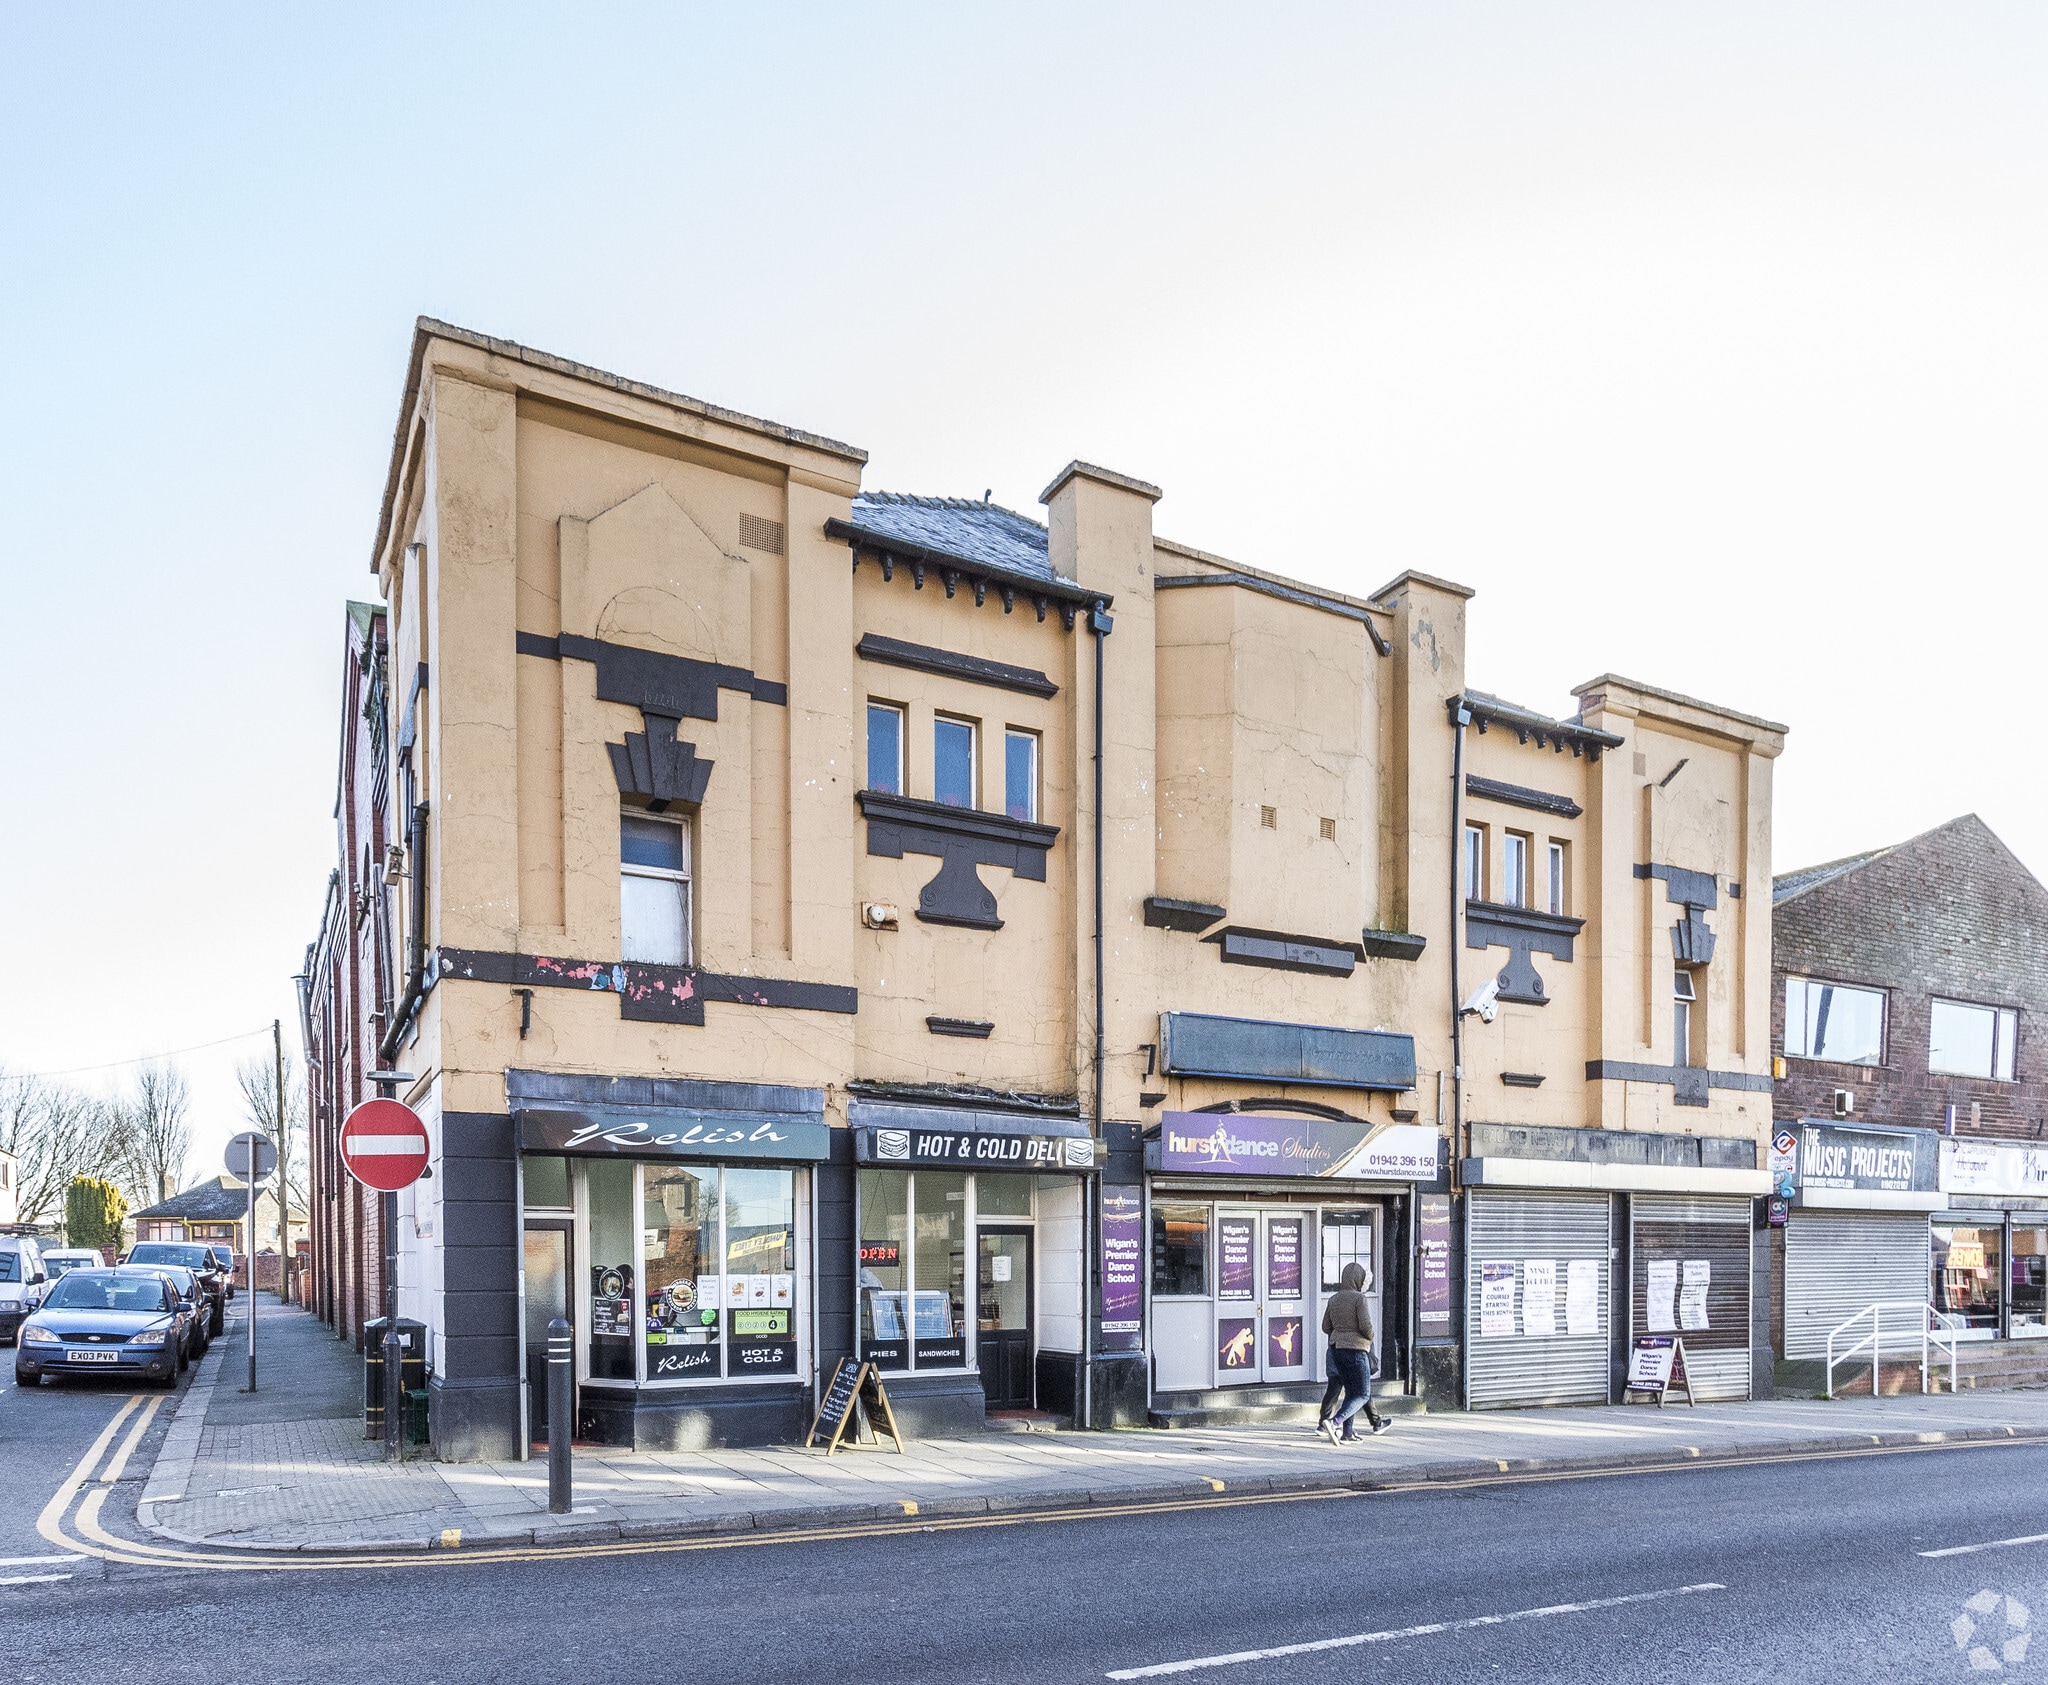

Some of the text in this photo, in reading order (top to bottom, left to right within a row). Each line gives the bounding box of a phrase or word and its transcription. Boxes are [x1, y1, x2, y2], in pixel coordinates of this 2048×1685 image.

[564, 1122, 788, 1148] Relish
[1804, 1128, 1820, 1146] THE
[917, 1136, 1062, 1161] HOT & COLD DELI
[1282, 1136, 1332, 1162] Studios
[1370, 1154, 1434, 1166] 01942 396 150
[1803, 1146, 1912, 1180] MUSIC PROJECTS
[1360, 1168, 1434, 1176] www.hurstdance.co.uk
[1222, 1226, 1249, 1235] Wigan's
[1272, 1226, 1297, 1235] Wigan's
[1222, 1235, 1249, 1244] Premier
[1272, 1235, 1298, 1243] Premier
[1105, 1238, 1138, 1250] Wigan's
[860, 1248, 897, 1259] OPEN
[1105, 1250, 1138, 1260] Premier
[1274, 1254, 1296, 1262] School
[1224, 1254, 1247, 1263] School
[1108, 1262, 1135, 1271] Dance
[1425, 1260, 1445, 1268] Dance
[1107, 1273, 1136, 1282] School
[1424, 1270, 1446, 1279] School
[770, 1321, 776, 1329] 4
[657, 1351, 711, 1373] Relish
